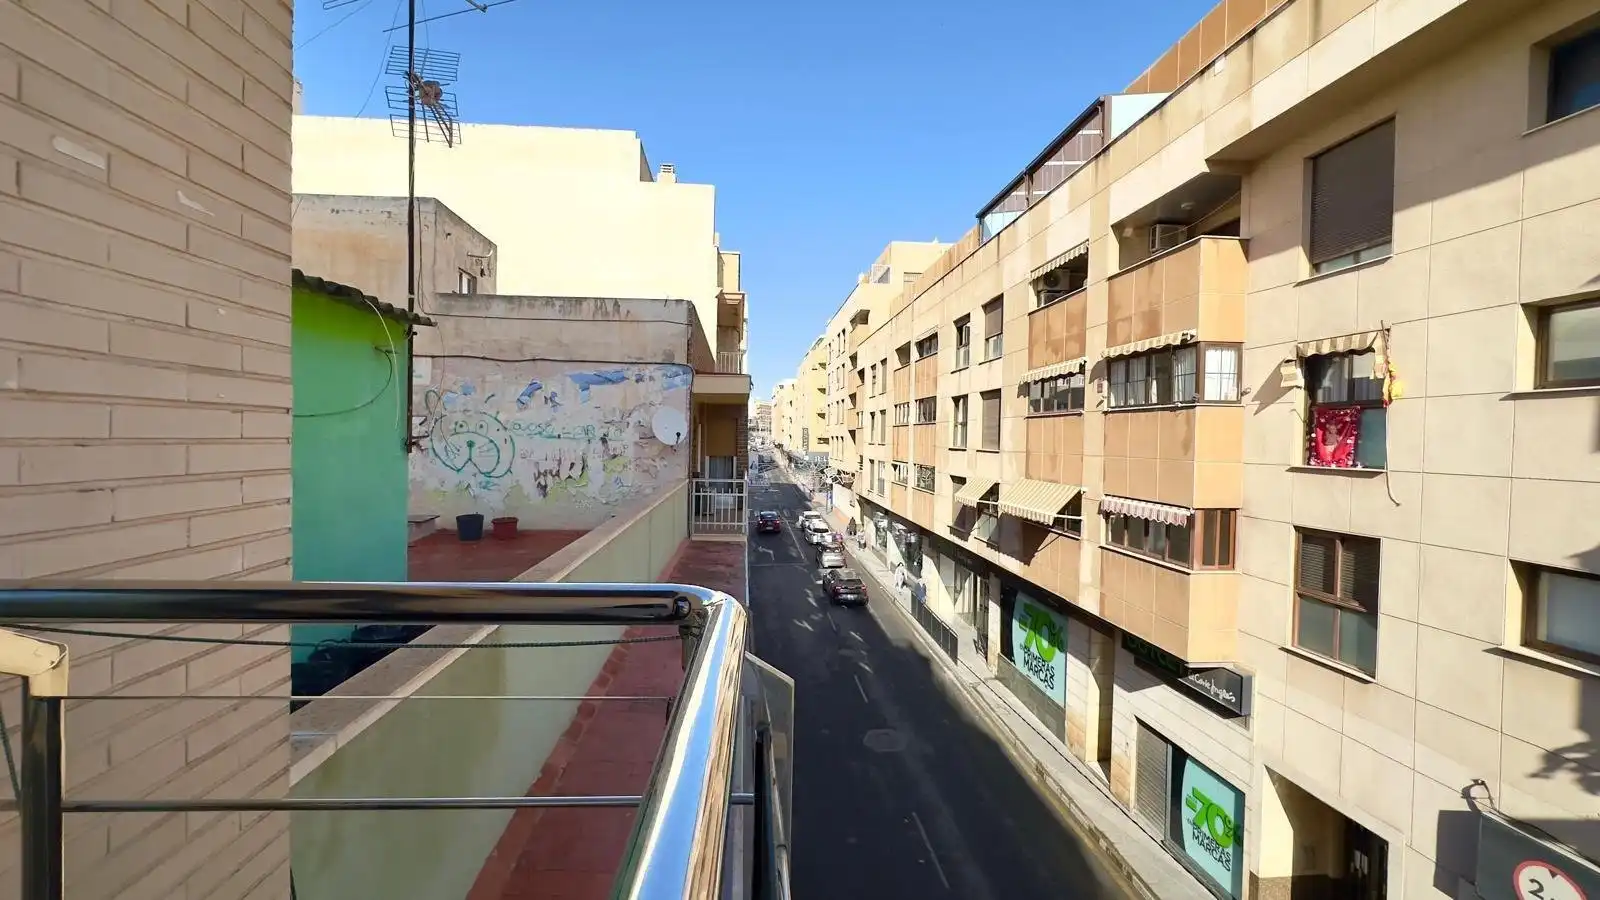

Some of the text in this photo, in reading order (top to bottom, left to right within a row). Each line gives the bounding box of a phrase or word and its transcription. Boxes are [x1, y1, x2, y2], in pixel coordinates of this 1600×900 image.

[1023, 648, 1055, 678] PRIMERAS
[1023, 658, 1055, 690] MARCAS
[1194, 673, 1211, 689] Corte
[1210, 678, 1236, 703] Inglés
[1192, 824, 1231, 859] PRIMERAS
[1192, 833, 1231, 872] MARCAS
